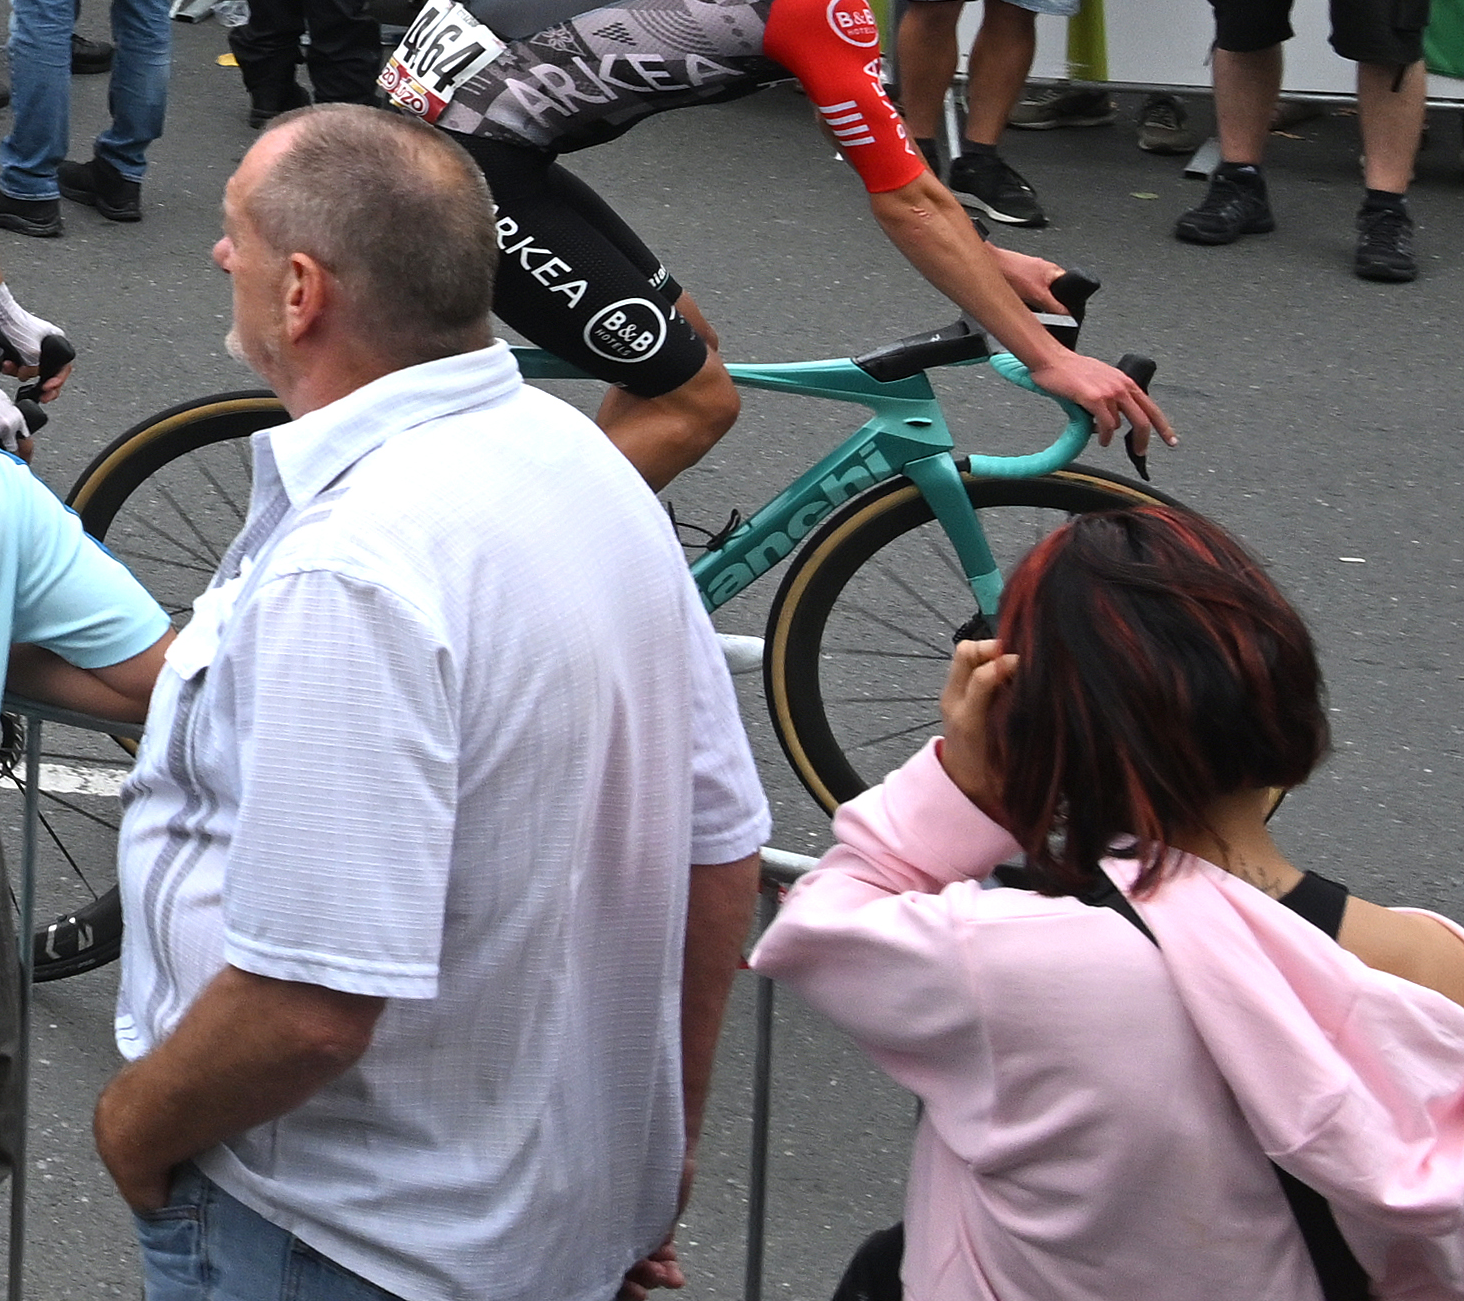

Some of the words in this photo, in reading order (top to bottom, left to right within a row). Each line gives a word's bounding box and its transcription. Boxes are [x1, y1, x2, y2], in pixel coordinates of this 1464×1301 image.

[835, 8, 876, 28] B&B
[505, 51, 744, 119] ARKEA
[491, 204, 589, 310] RKEA
[594, 328, 633, 357] HOTELS
[601, 309, 655, 352] B&B
[707, 444, 897, 604] anchi
